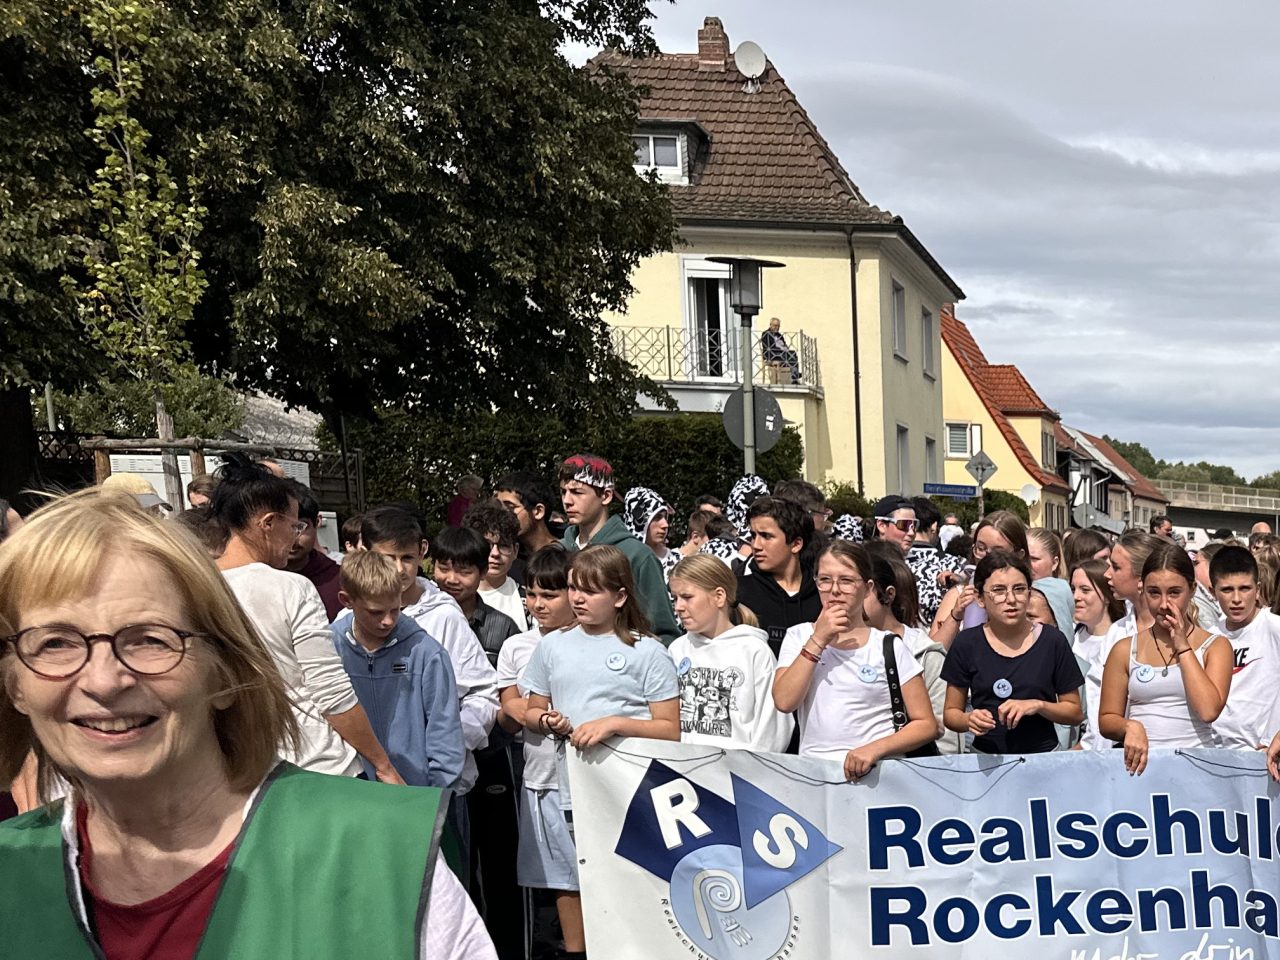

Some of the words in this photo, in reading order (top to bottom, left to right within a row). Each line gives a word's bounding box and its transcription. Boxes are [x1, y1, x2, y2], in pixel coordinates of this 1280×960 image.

[1233, 647, 1250, 667] KE
[650, 777, 713, 850] R
[753, 812, 809, 869] S
